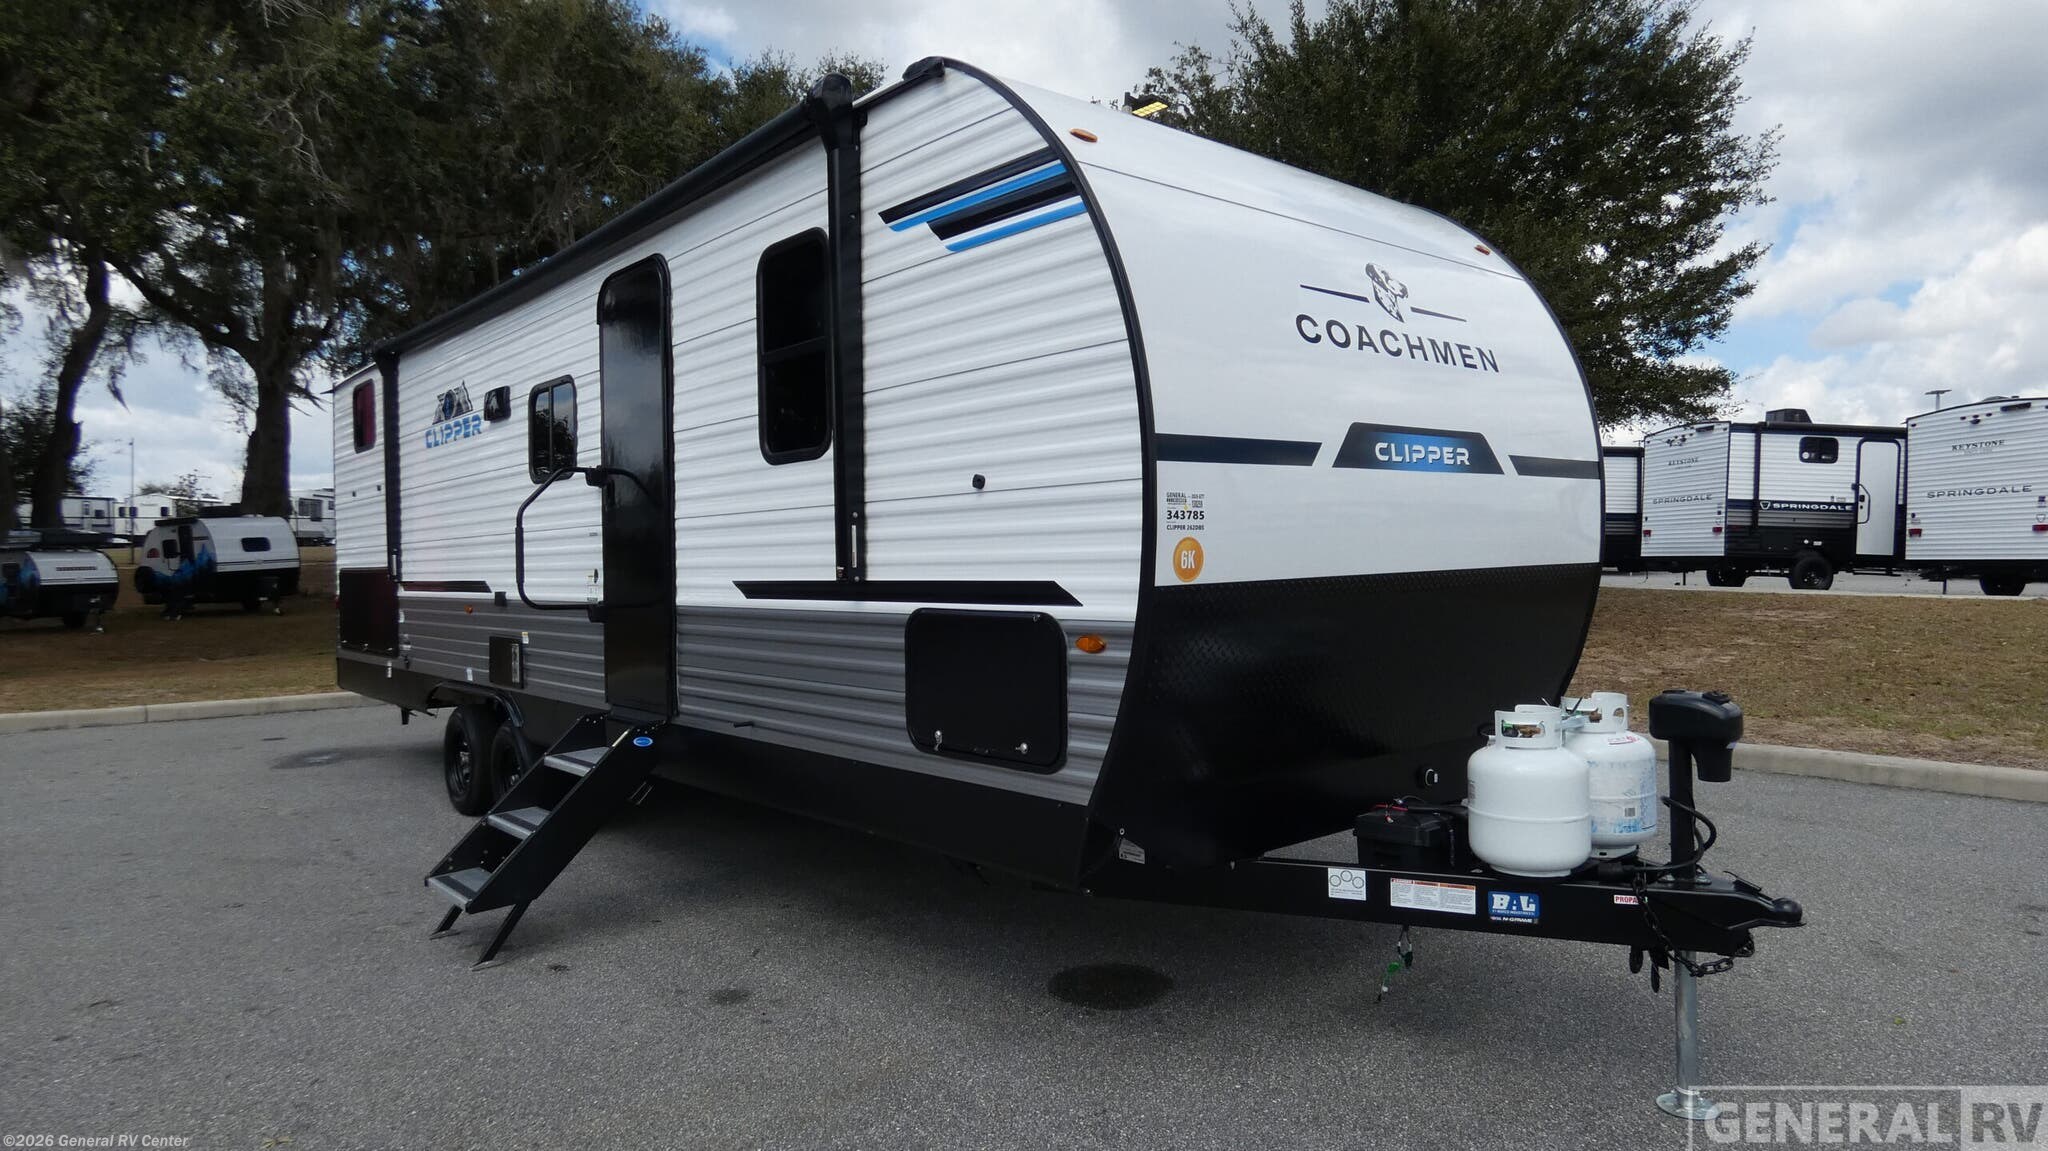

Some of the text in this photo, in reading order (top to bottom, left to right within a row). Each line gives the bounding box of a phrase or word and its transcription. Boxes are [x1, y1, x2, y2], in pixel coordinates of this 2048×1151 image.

[1296, 314, 1499, 373] COACHMEN
[425, 413, 482, 449] CLIPPER
[1951, 439, 2006, 451] KEYSTONE
[1375, 441, 1470, 466] CLIPPER
[1927, 484, 2033, 499] SPRINGDALE
[1652, 493, 1713, 505] SPRINGDALE
[1772, 502, 1854, 511] SPRINGDALE
[1166, 510, 1205, 520] 343785
[1181, 550, 1196, 569] 6K
[1616, 896, 1638, 904] PROPA
